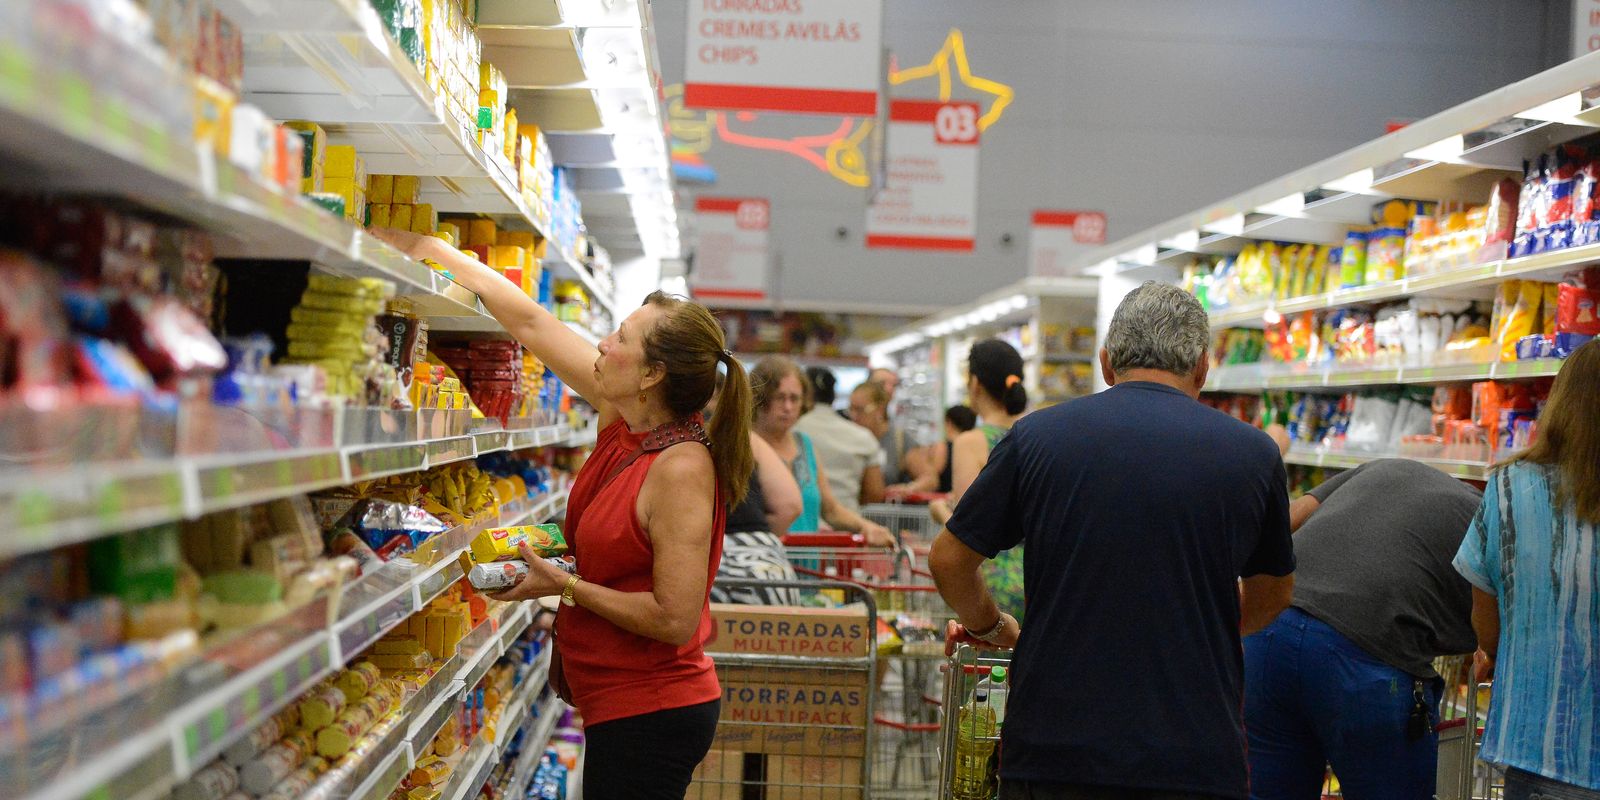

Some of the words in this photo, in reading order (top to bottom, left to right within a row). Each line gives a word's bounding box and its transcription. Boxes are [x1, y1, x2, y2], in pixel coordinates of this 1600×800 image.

[703, 0, 803, 14] TORRADAS
[699, 19, 779, 40] CREMES
[785, 18, 861, 42] AVELÃS
[699, 45, 758, 65] CHIPS
[936, 104, 977, 141] 03
[392, 335, 403, 367] piraqu
[724, 620, 861, 638] TORRADAS
[733, 639, 853, 653] MULTIPACK
[726, 687, 860, 705] TORRADAS
[732, 709, 852, 725] MULTIPACK
